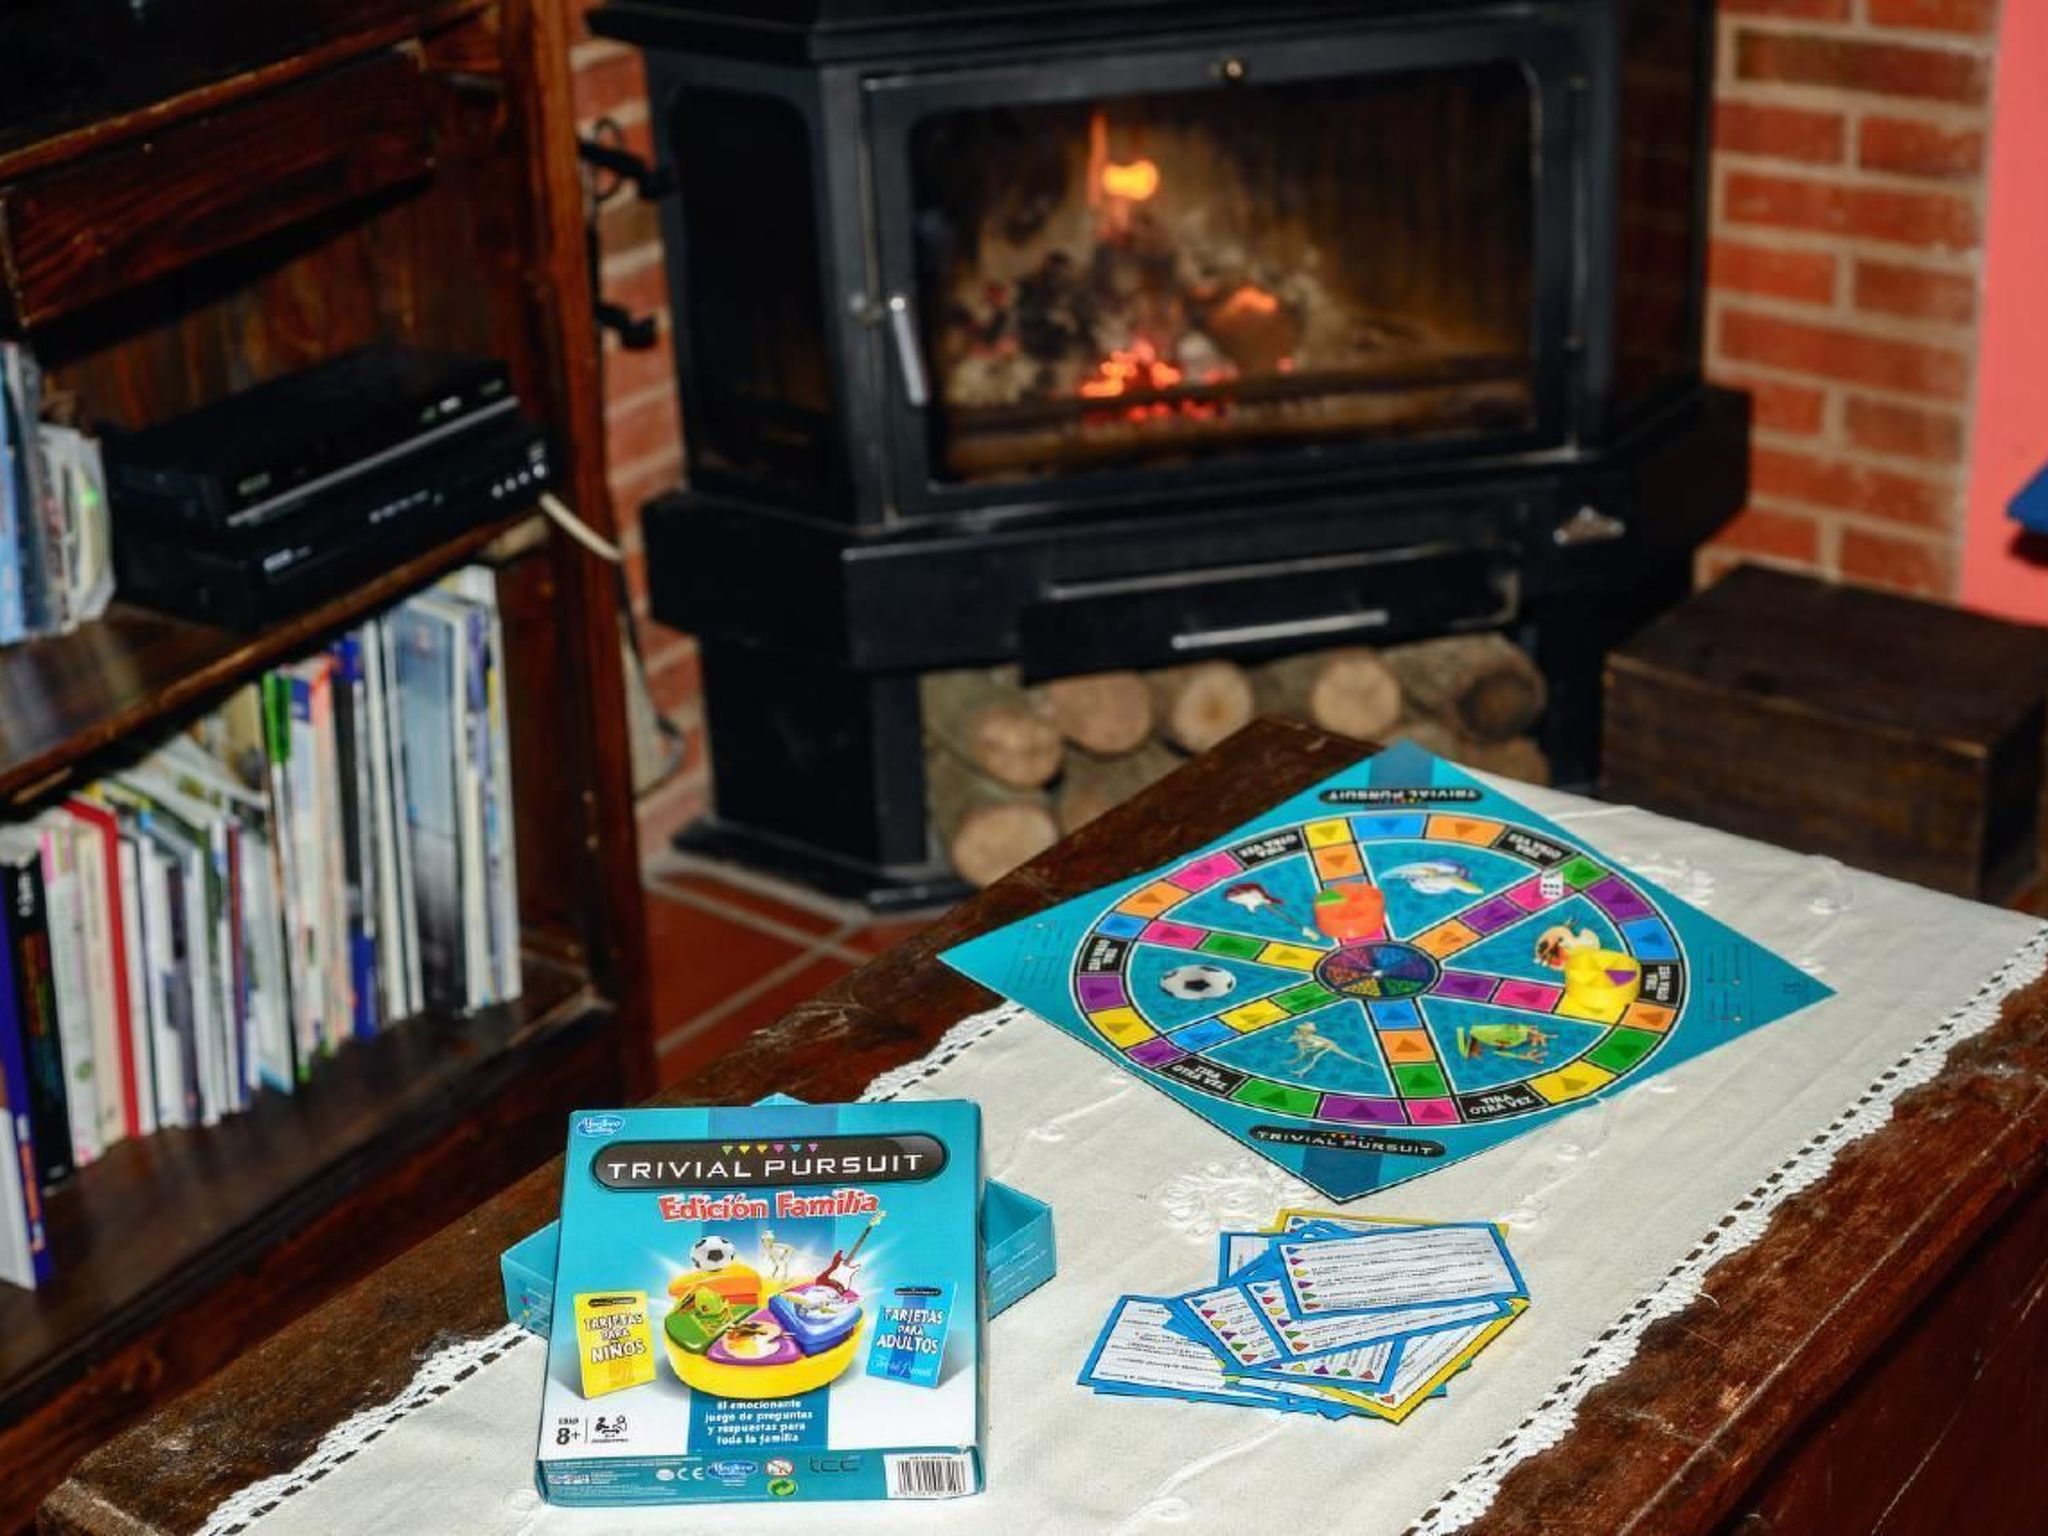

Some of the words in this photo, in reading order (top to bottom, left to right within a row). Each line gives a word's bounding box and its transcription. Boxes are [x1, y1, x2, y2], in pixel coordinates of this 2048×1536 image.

[1257, 1131, 1339, 1146] TRIVIAL
[1343, 1140, 1434, 1155] PURSUIT
[607, 1161, 752, 1180] TRIVIAL
[765, 1154, 923, 1177] PURSUIT
[658, 1193, 768, 1222] Edición
[776, 1189, 879, 1219] Familia
[584, 1313, 643, 1331] TARJETAS
[884, 1308, 944, 1325] TARJETAS
[591, 1340, 647, 1364] NIÑOS
[877, 1334, 939, 1354] ADULTOS
[705, 1411, 736, 1424] juego
[739, 1411, 754, 1421] de
[756, 1411, 813, 1423] preguntas
[556, 1427, 581, 1445] 8+
[707, 1426, 715, 1436] y
[718, 1423, 778, 1434] respuestas
[780, 1423, 806, 1433] para
[745, 1433, 757, 1444] la
[759, 1433, 799, 1446] familia
